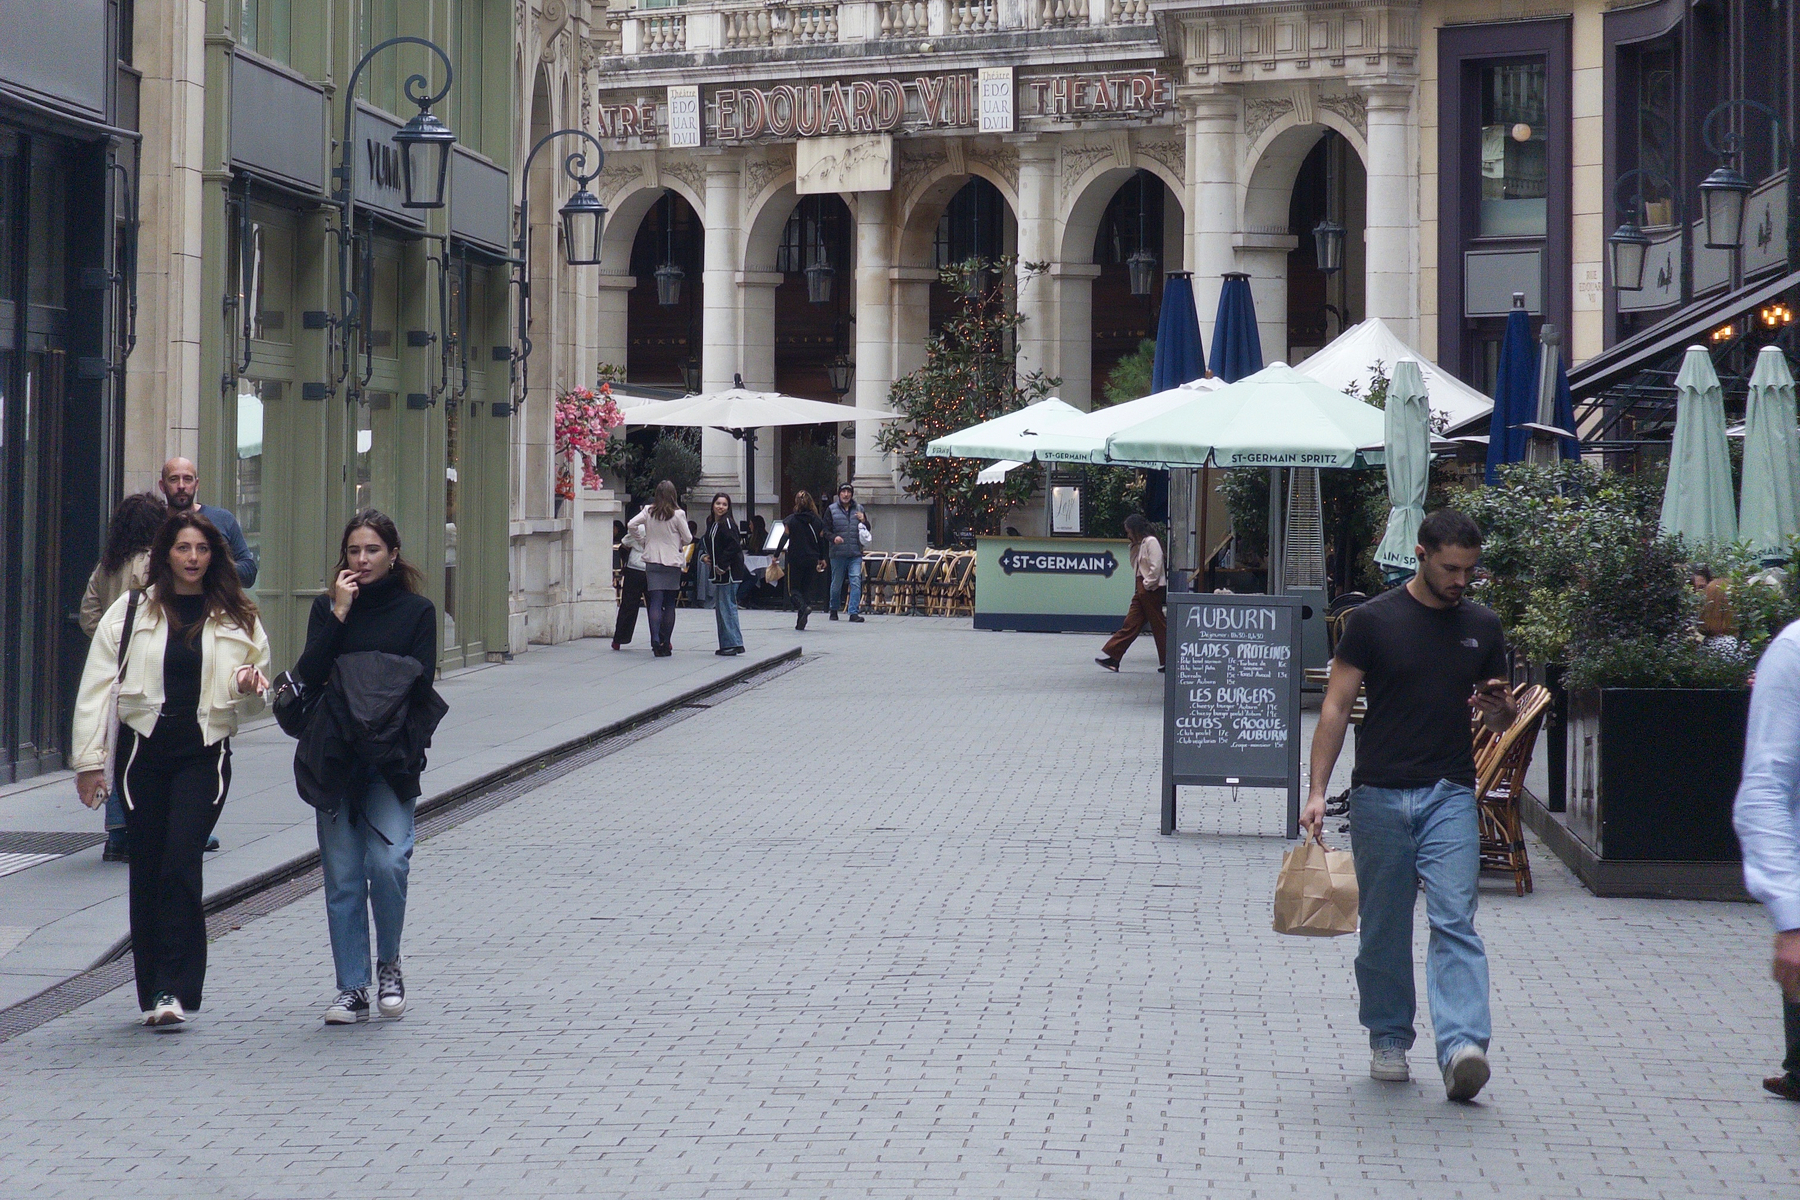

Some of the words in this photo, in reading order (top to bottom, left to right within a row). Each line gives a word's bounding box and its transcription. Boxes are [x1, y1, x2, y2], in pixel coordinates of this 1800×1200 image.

[983, 82, 1010, 97] EDO
[672, 100, 696, 114] EDO
[716, 78, 905, 140] EDOUARD
[916, 74, 973, 128] VII
[983, 99, 1011, 113] UAR
[672, 116, 697, 130] UAR
[1231, 453, 1296, 463] ST-GERMAIN
[1301, 454, 1337, 464] SPRITZ
[1186, 606, 1276, 630] AUBURN
[1180, 642, 1230, 658] SALADES
[1189, 687, 1212, 702] LES
[1217, 686, 1276, 704] BURGERS
[1176, 717, 1222, 729] CLUBS
[1237, 729, 1288, 741] AUBURN
